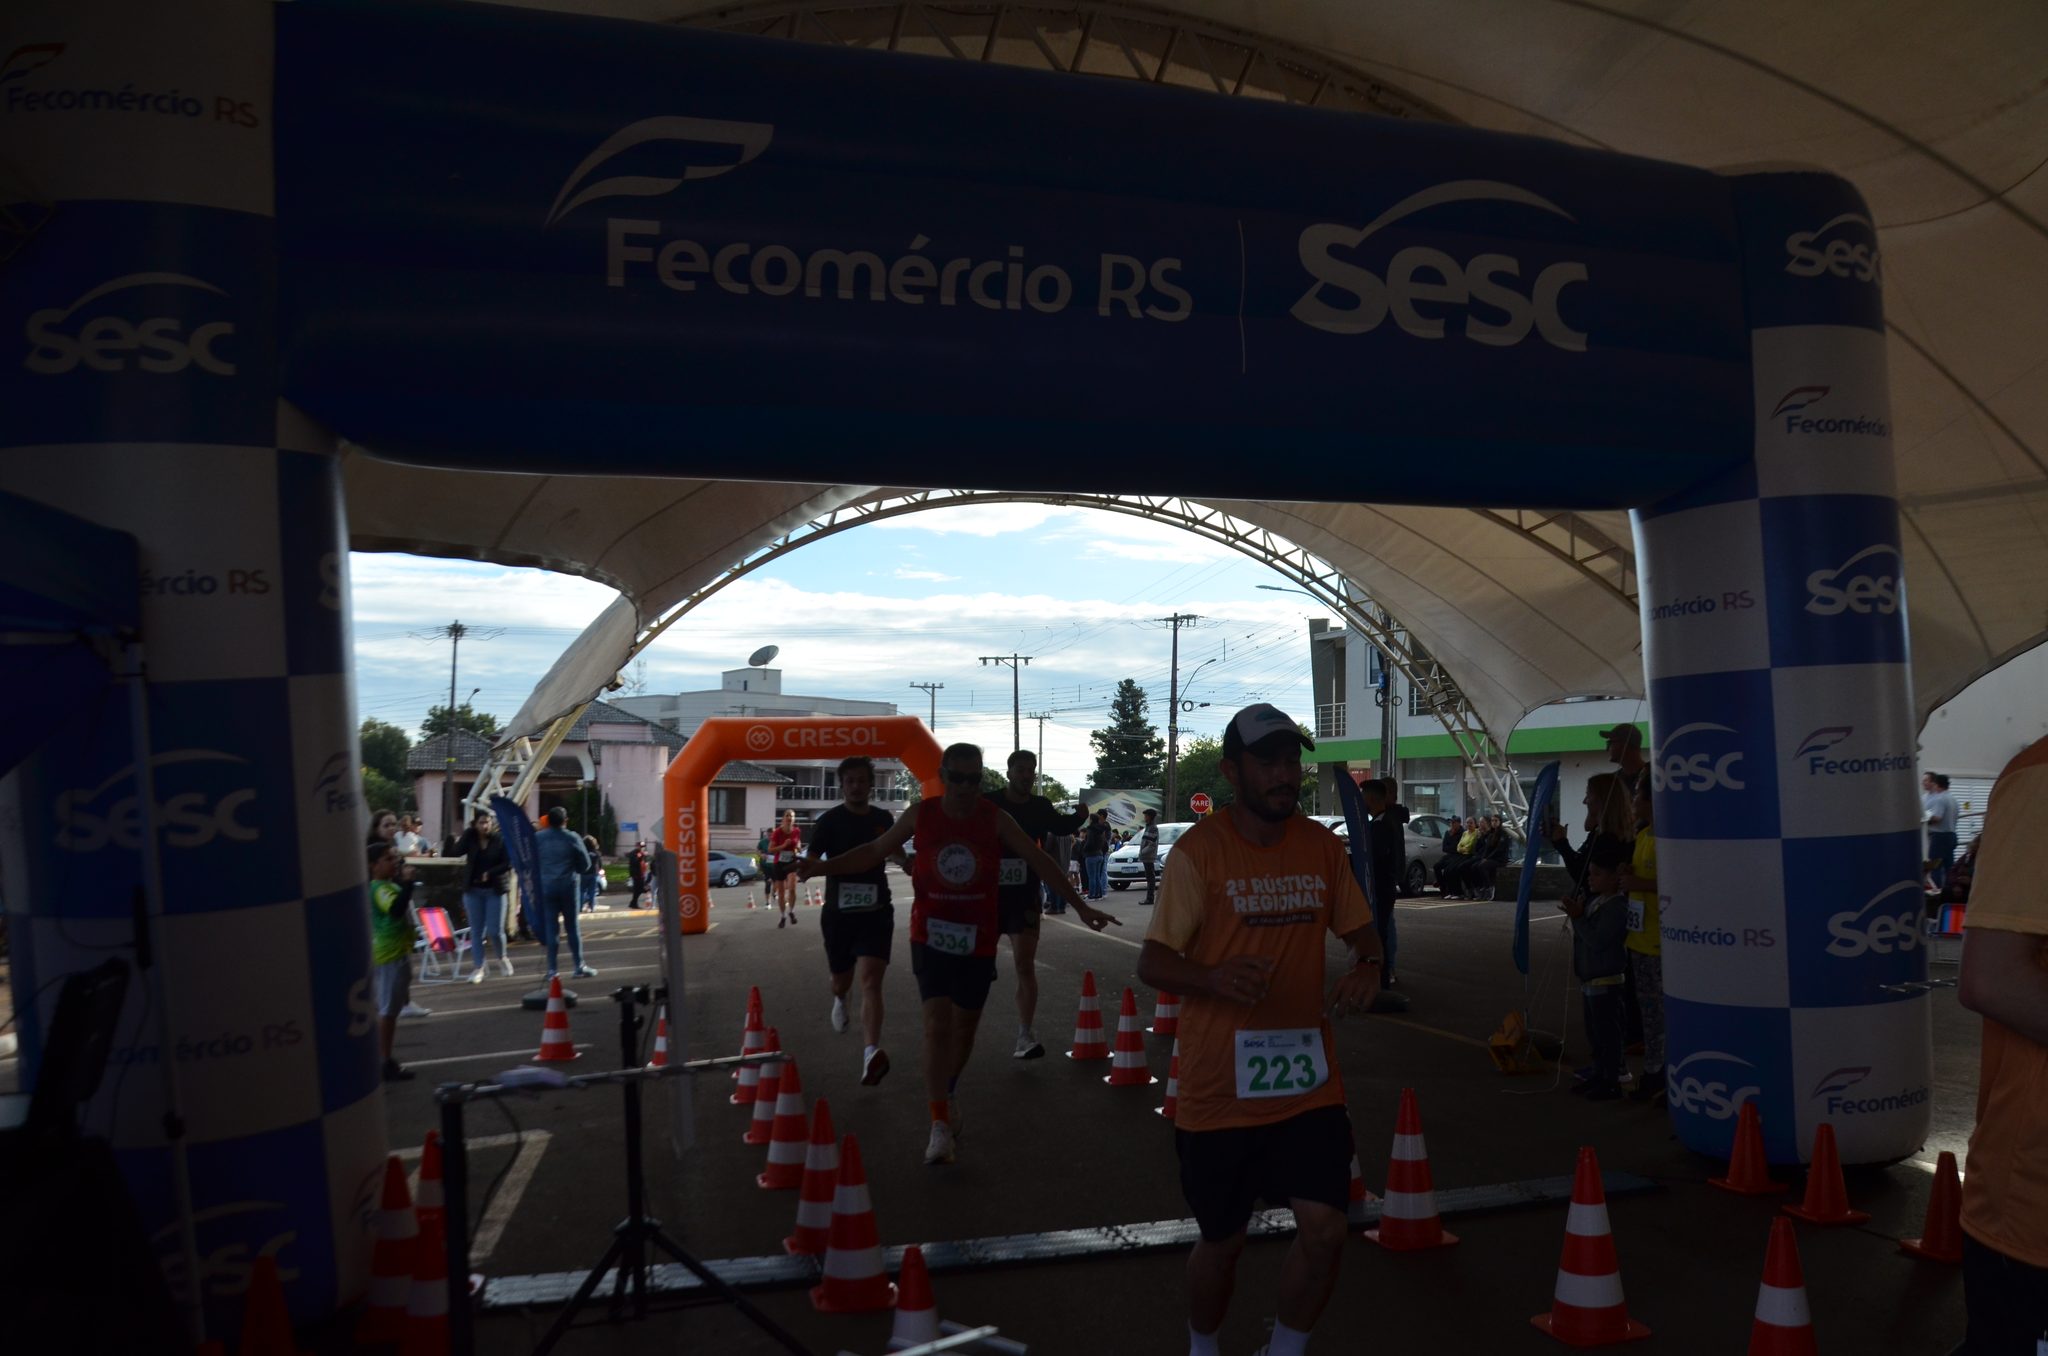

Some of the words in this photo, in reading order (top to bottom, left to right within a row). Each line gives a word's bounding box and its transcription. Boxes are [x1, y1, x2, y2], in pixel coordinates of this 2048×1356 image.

[7, 83, 203, 118] Fecomércio
[214, 96, 259, 128] RS
[606, 217, 1073, 314] Fecomércio
[1098, 252, 1193, 322] RS
[1289, 222, 1590, 353] Sesc
[22, 308, 237, 376] Sesc
[227, 569, 270, 595] RS
[1723, 590, 1755, 611] RS
[783, 726, 886, 748] CRESOL
[1191, 799, 1210, 807] PARE
[55, 788, 260, 854] Sesc
[677, 800, 697, 888] CRESOL
[1250, 873, 1327, 895] RÚSTICA
[843, 893, 873, 905] 256
[1232, 891, 1326, 913] REGIONAL
[934, 932, 969, 952] 334
[1660, 926, 1735, 946] ecomércio
[1743, 928, 1776, 948] RS
[262, 1020, 304, 1050] RS
[1247, 1053, 1317, 1092] 223
